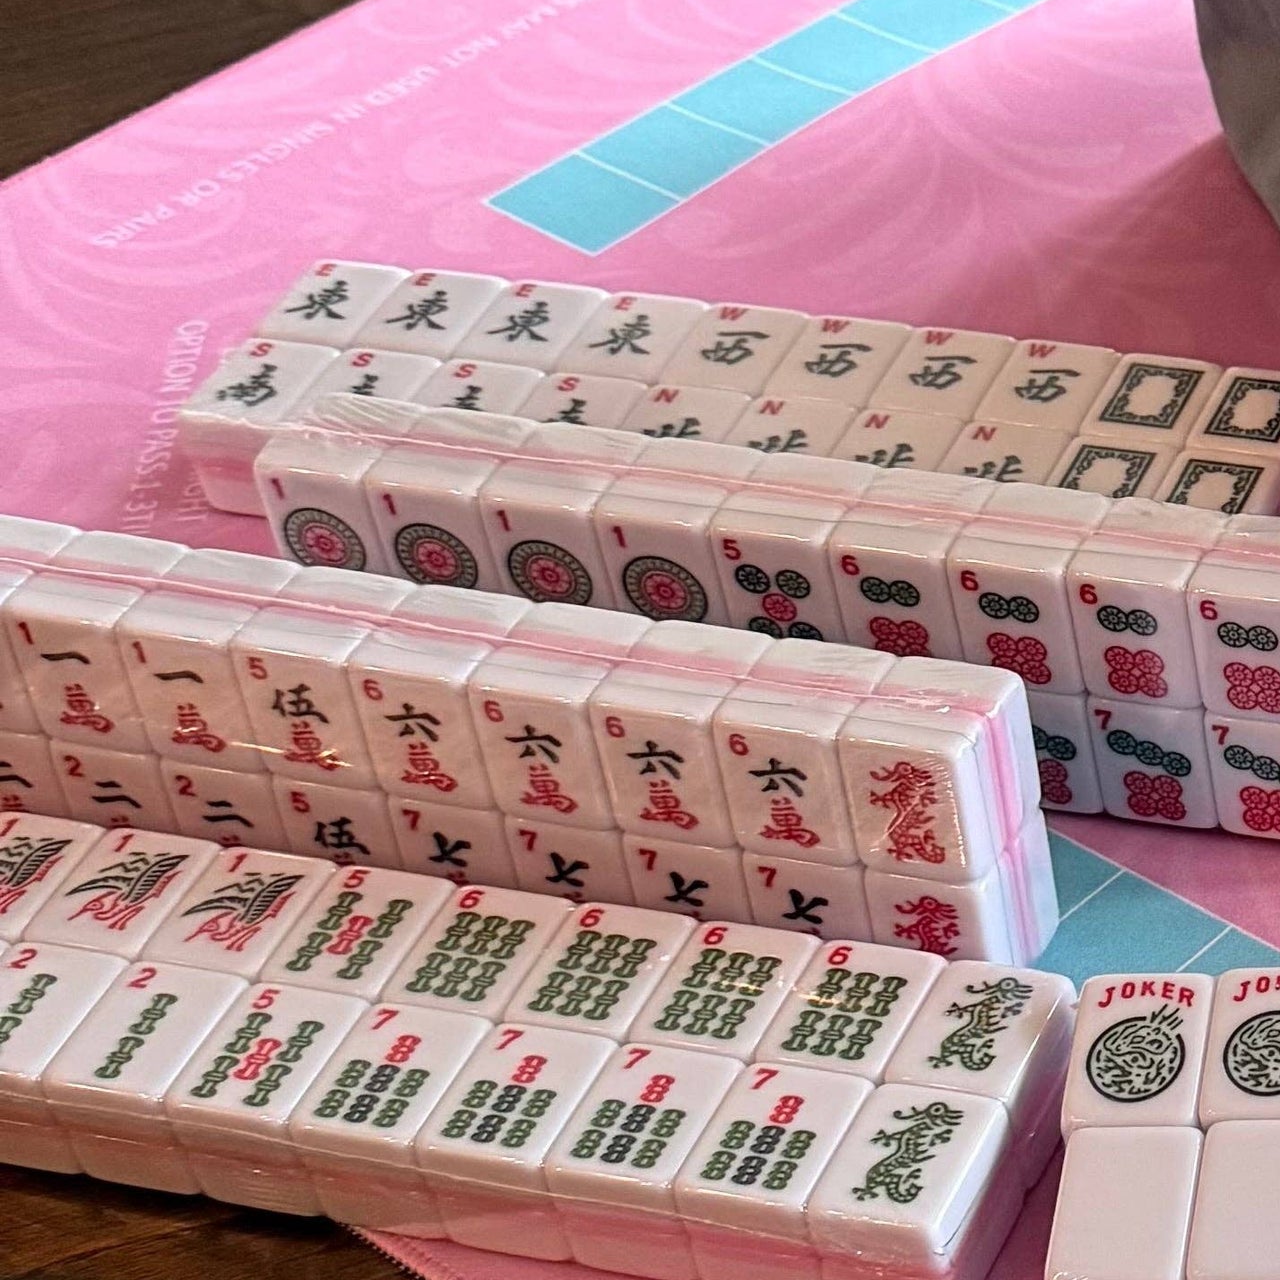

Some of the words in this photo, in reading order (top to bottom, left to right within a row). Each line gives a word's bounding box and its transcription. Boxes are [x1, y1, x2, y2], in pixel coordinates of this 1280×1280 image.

[90, 204, 176, 248] PAIRS
[315, 263, 336, 277] E
[415, 273, 436, 287] E
[285, 280, 349, 320] 東
[515, 284, 537, 297] E
[386, 291, 449, 331] 東
[614, 297, 637, 311] E
[719, 307, 748, 320] W
[487, 302, 551, 342] 東
[822, 319, 849, 333] W
[589, 315, 651, 356] 東
[925, 331, 952, 345] W
[157, 321, 208, 394] OPTION
[250, 343, 273, 357] S
[701, 332, 769, 364] 西
[1028, 344, 1055, 358] W
[352, 353, 373, 367] S
[805, 343, 872, 377] 西
[454, 364, 477, 378] S
[909, 356, 977, 390] 西
[557, 377, 580, 391] S
[1015, 370, 1081, 402] 西
[653, 389, 678, 404] N
[760, 400, 783, 415] N
[865, 415, 889, 429] N
[973, 427, 996, 442] N
[384, 494, 396, 515] 1
[498, 510, 511, 531] 1
[614, 526, 627, 548] 1
[723, 538, 741, 560] 5
[841, 554, 861, 576] 6
[960, 570, 979, 591] 6
[1079, 584, 1098, 605] 6
[1199, 600, 1218, 620] 6
[19, 622, 33, 645] 1
[132, 641, 147, 663] 1
[248, 657, 268, 680] 5
[362, 679, 383, 700] 6
[484, 701, 504, 722] 6
[1095, 709, 1111, 731] 7
[605, 716, 626, 738] 6
[1212, 724, 1229, 745] 7
[729, 733, 750, 756] 6
[64, 755, 85, 777] 2
[175, 775, 197, 797] 2
[290, 791, 311, 813] 5
[403, 810, 422, 830] 7
[114, 834, 134, 852] 1
[520, 829, 537, 851] 7
[228, 853, 248, 872] 1
[638, 848, 657, 870] 7
[344, 870, 370, 888] 5
[758, 866, 777, 888] 7
[459, 890, 485, 909] 6
[579, 909, 606, 929] 6
[703, 926, 729, 945] 6
[8, 948, 38, 969] 2
[827, 946, 853, 966] 6
[127, 968, 157, 989] 2
[253, 989, 280, 1009] 5
[1098, 980, 1195, 1008] JOKER
[371, 1009, 399, 1030] 7
[496, 1030, 524, 1050] 7
[623, 1049, 651, 1070] 7
[749, 1068, 779, 1091] 7
